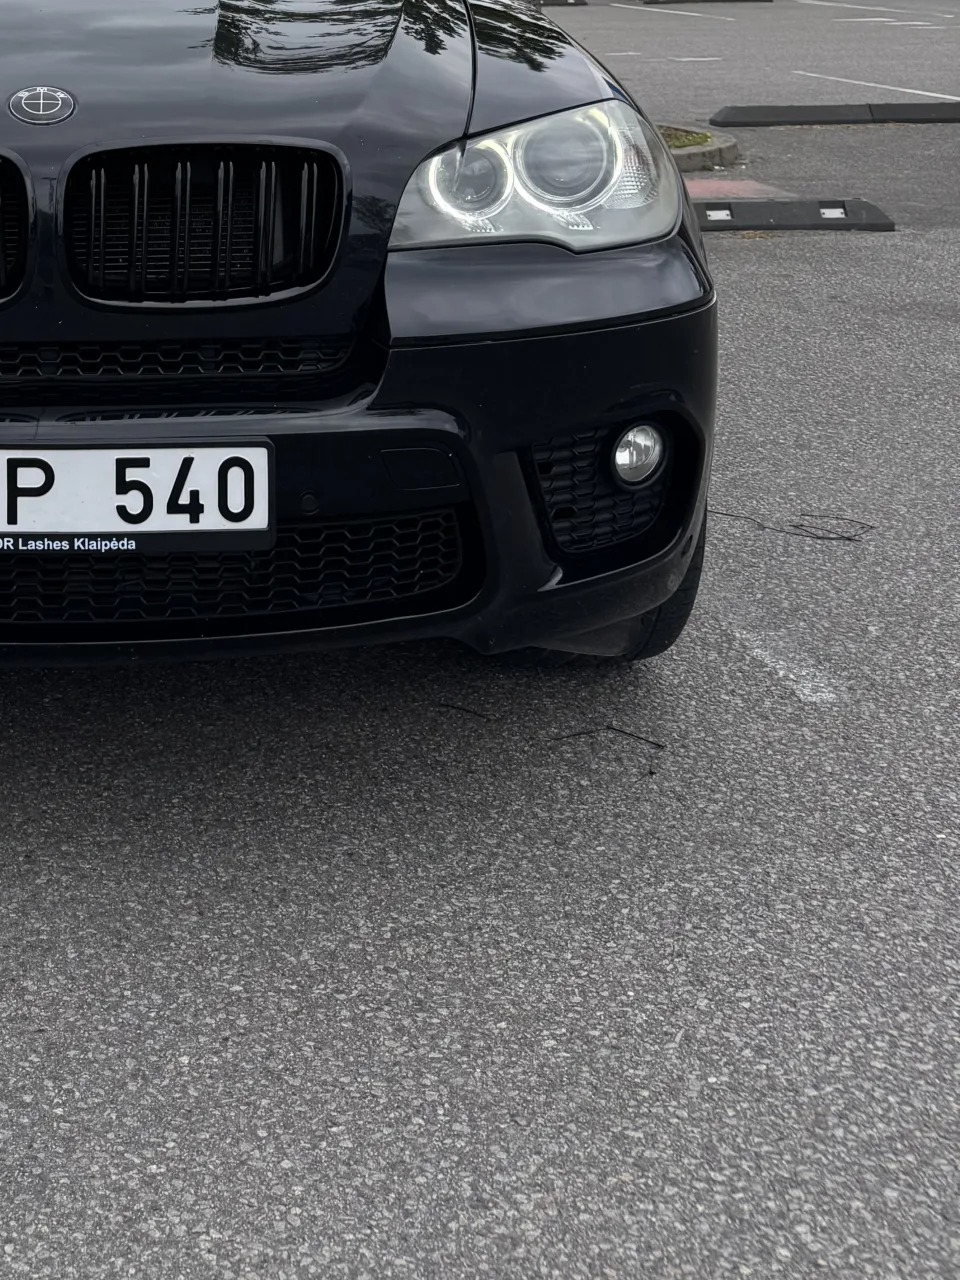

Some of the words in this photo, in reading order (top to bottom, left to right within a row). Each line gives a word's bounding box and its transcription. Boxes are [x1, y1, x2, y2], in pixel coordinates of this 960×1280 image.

[17, 86, 68, 98] BMW
[115, 456, 255, 524] 540
[19, 538, 69, 550] Lashes
[74, 537, 136, 552] Klaipėda
